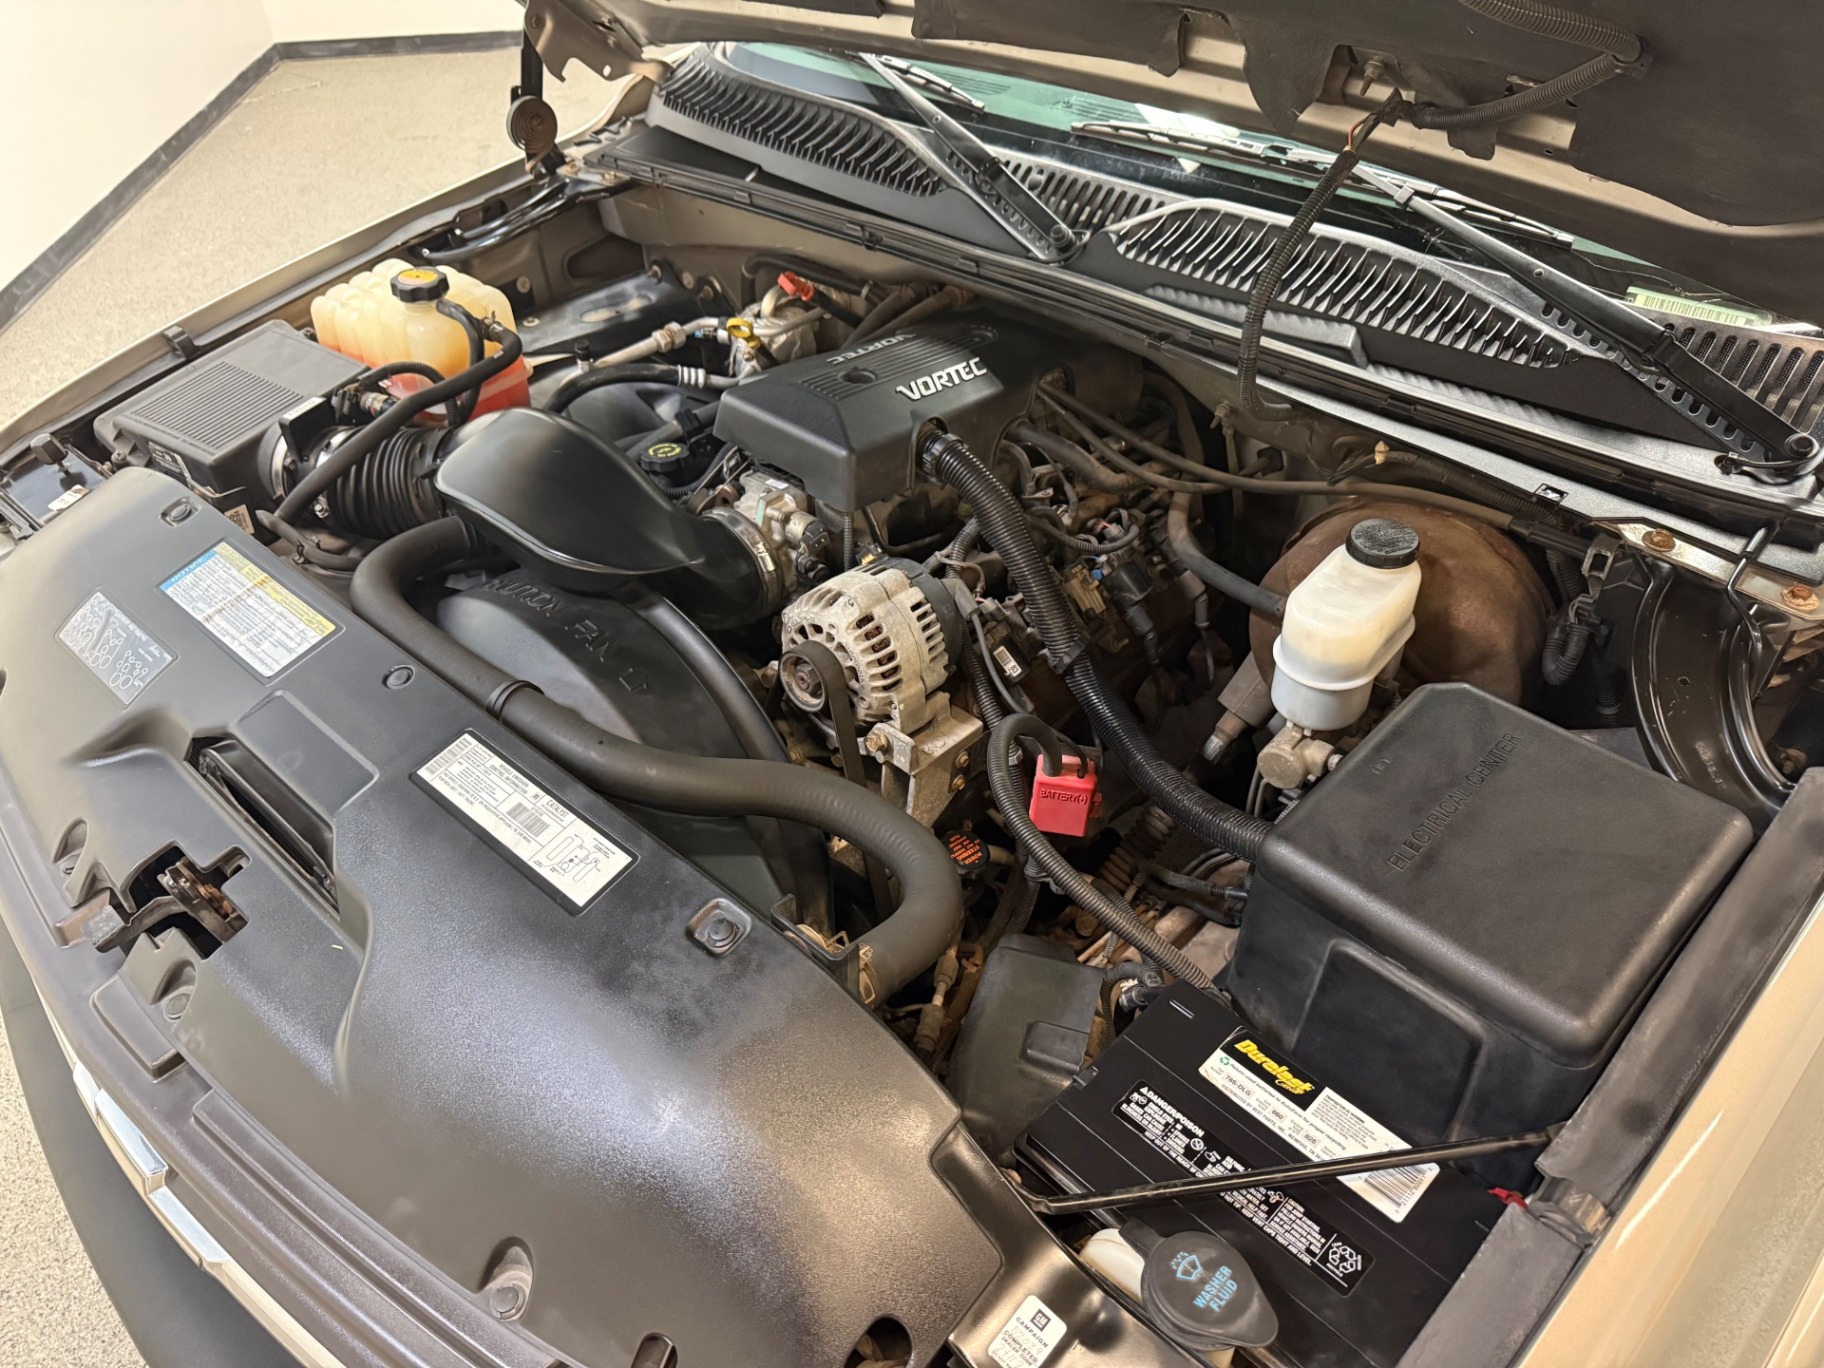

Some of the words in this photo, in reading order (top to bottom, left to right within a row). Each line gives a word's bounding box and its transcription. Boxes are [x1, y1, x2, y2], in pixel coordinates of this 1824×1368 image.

[826, 332, 917, 365] VORTEC
[896, 357, 988, 401] VORTEC
[1040, 788, 1088, 805] BATTERY(+)
[1386, 786, 1473, 872] ELECTRICAL
[1464, 732, 1522, 787] CENTER
[1234, 1039, 1314, 1091] Duralast
[1145, 1090, 1205, 1138] DANGER/POISON
[1193, 1265, 1233, 1308] WASHER
[1208, 1279, 1238, 1312] FLUID
[1004, 1330, 1038, 1363] COMPLETED
[1016, 1316, 1049, 1348] CAMPAIGN
